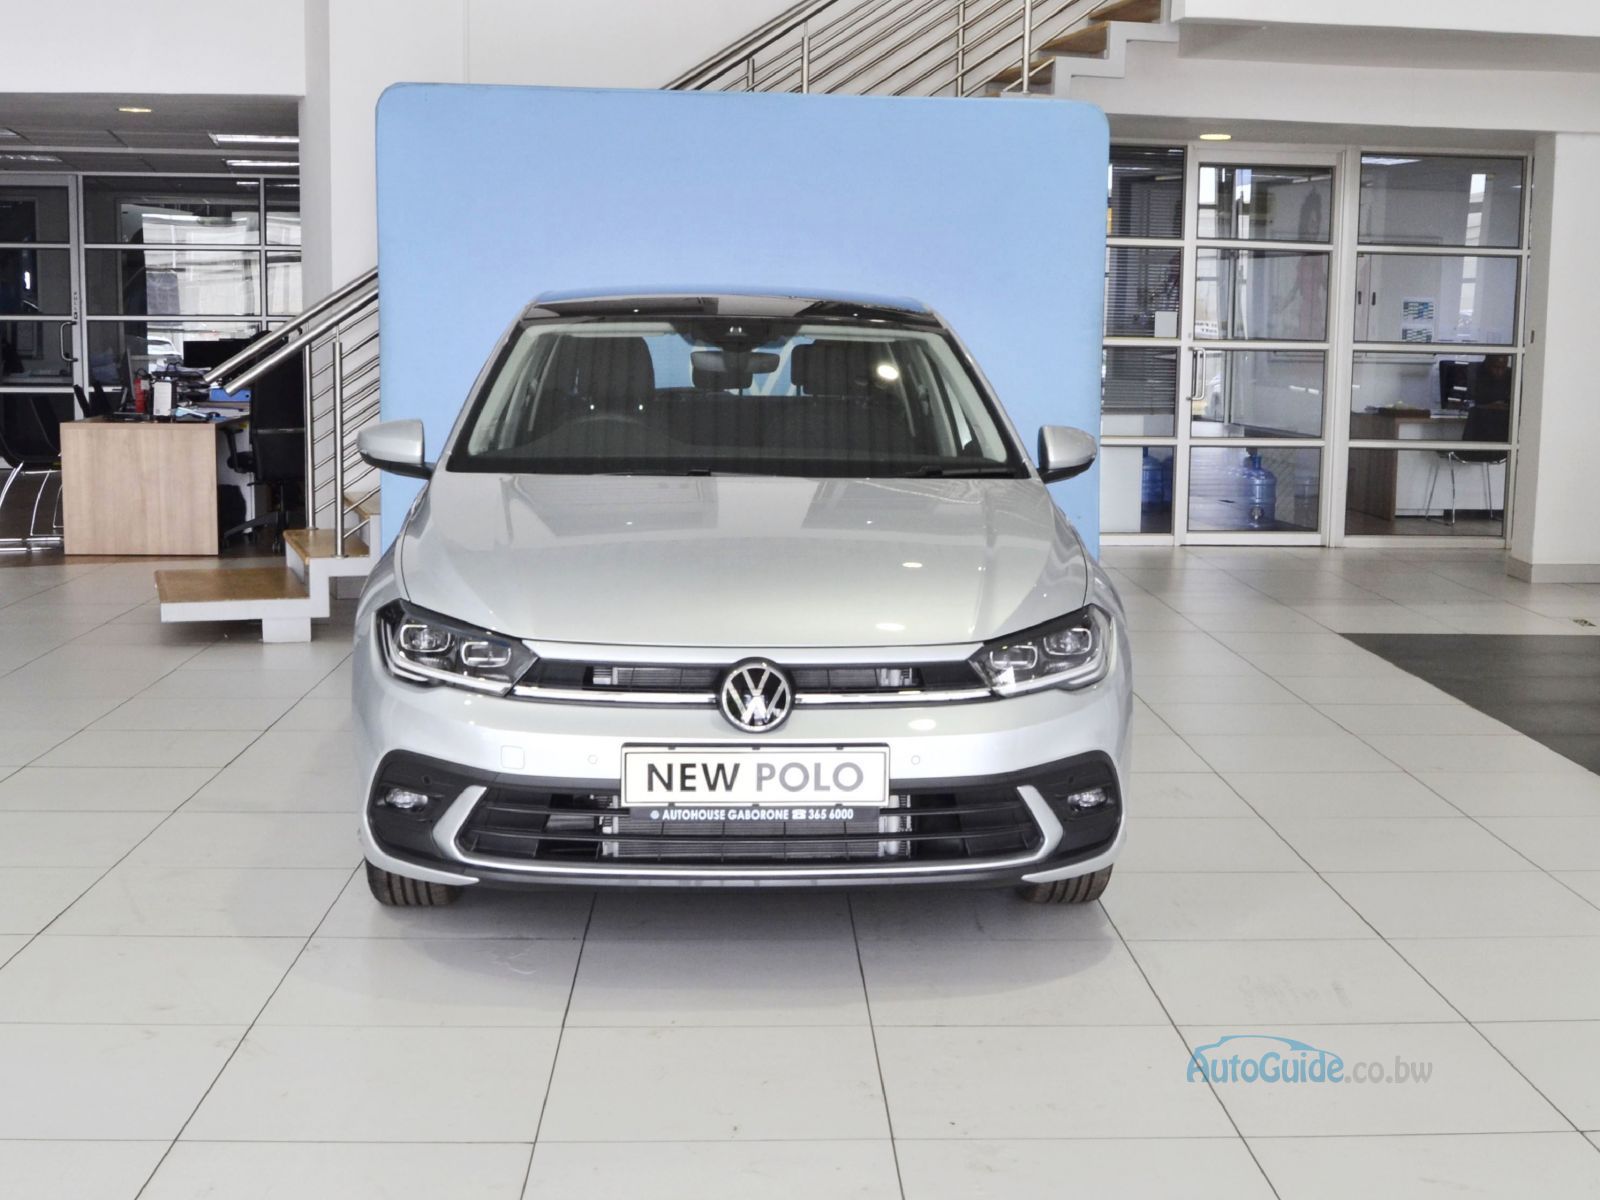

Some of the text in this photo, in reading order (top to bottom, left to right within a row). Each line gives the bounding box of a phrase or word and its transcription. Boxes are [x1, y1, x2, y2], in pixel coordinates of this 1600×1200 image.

[647, 761, 864, 792] NEW POLO
[662, 808, 854, 821] AUTOHOUSE GABORONE 365 6000
